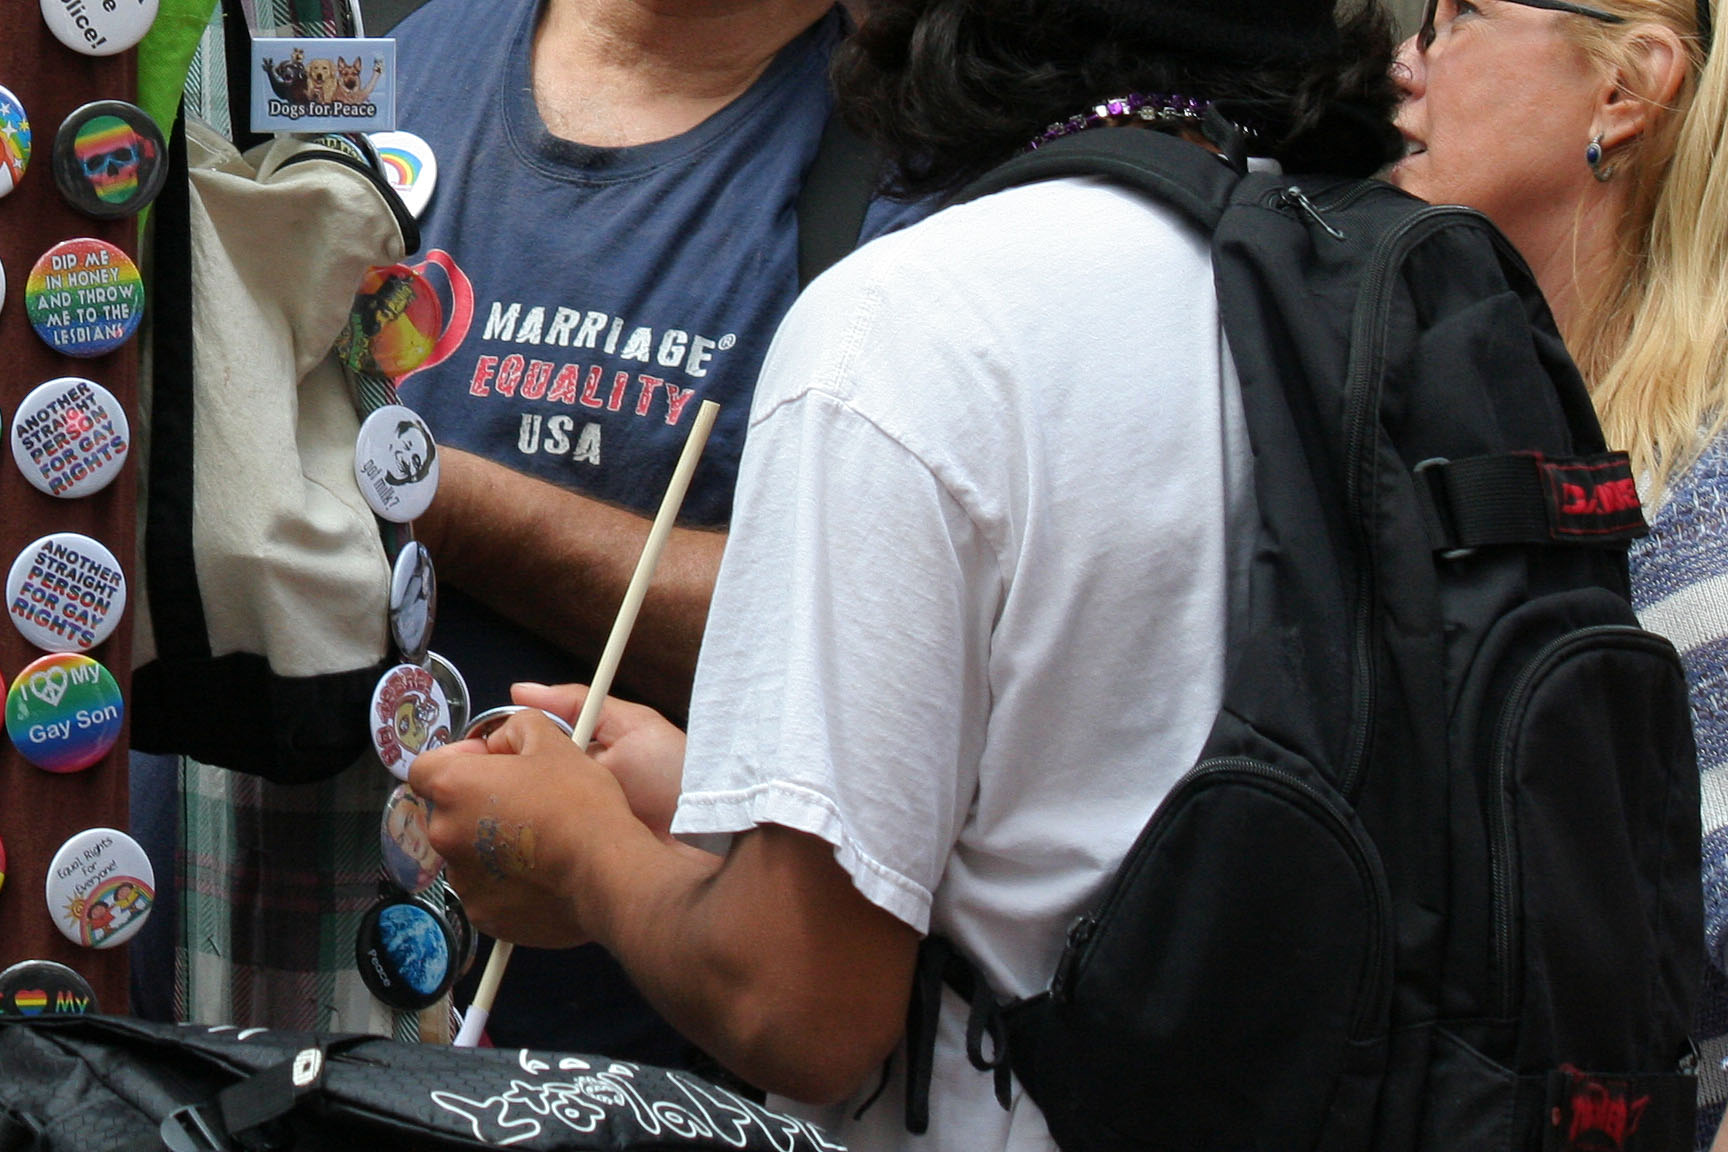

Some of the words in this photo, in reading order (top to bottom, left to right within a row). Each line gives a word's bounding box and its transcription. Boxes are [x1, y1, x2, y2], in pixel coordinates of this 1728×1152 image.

[270, 101, 305, 120] Dogs
[309, 101, 330, 116] for
[333, 101, 375, 116] Peace
[46, 274, 63, 289] IN
[67, 267, 120, 288] HONEY
[51, 254, 77, 271] DIP
[84, 250, 109, 267] ME
[38, 293, 72, 310] AND
[76, 284, 133, 305] THROW
[46, 310, 70, 327] ME
[76, 307, 98, 323] TO
[102, 303, 130, 321] THE
[53, 325, 124, 345] LESBIANS
[16, 381, 91, 439] ANOTHER
[470, 354, 696, 426] EQUALITY
[22, 395, 97, 450] STRAIGHT
[30, 405, 108, 465] PERSON
[518, 413, 602, 465] USA
[40, 450, 77, 480] FOR
[79, 420, 116, 453] GAY
[47, 434, 127, 496] RIGHTS
[373, 477, 400, 511] milk?
[34, 552, 118, 599] STRAIGHT
[40, 539, 122, 587] ANOTHER
[19, 581, 59, 609] FOR
[62, 601, 104, 630] GAY
[27, 565, 111, 615] PERSON
[10, 598, 95, 648] RIGHTS
[71, 664, 101, 688] My
[29, 718, 70, 745] Gay
[76, 705, 118, 729] Son
[83, 836, 113, 860] Rights
[368, 949, 392, 988] Peace
[55, 991, 88, 1014] My
